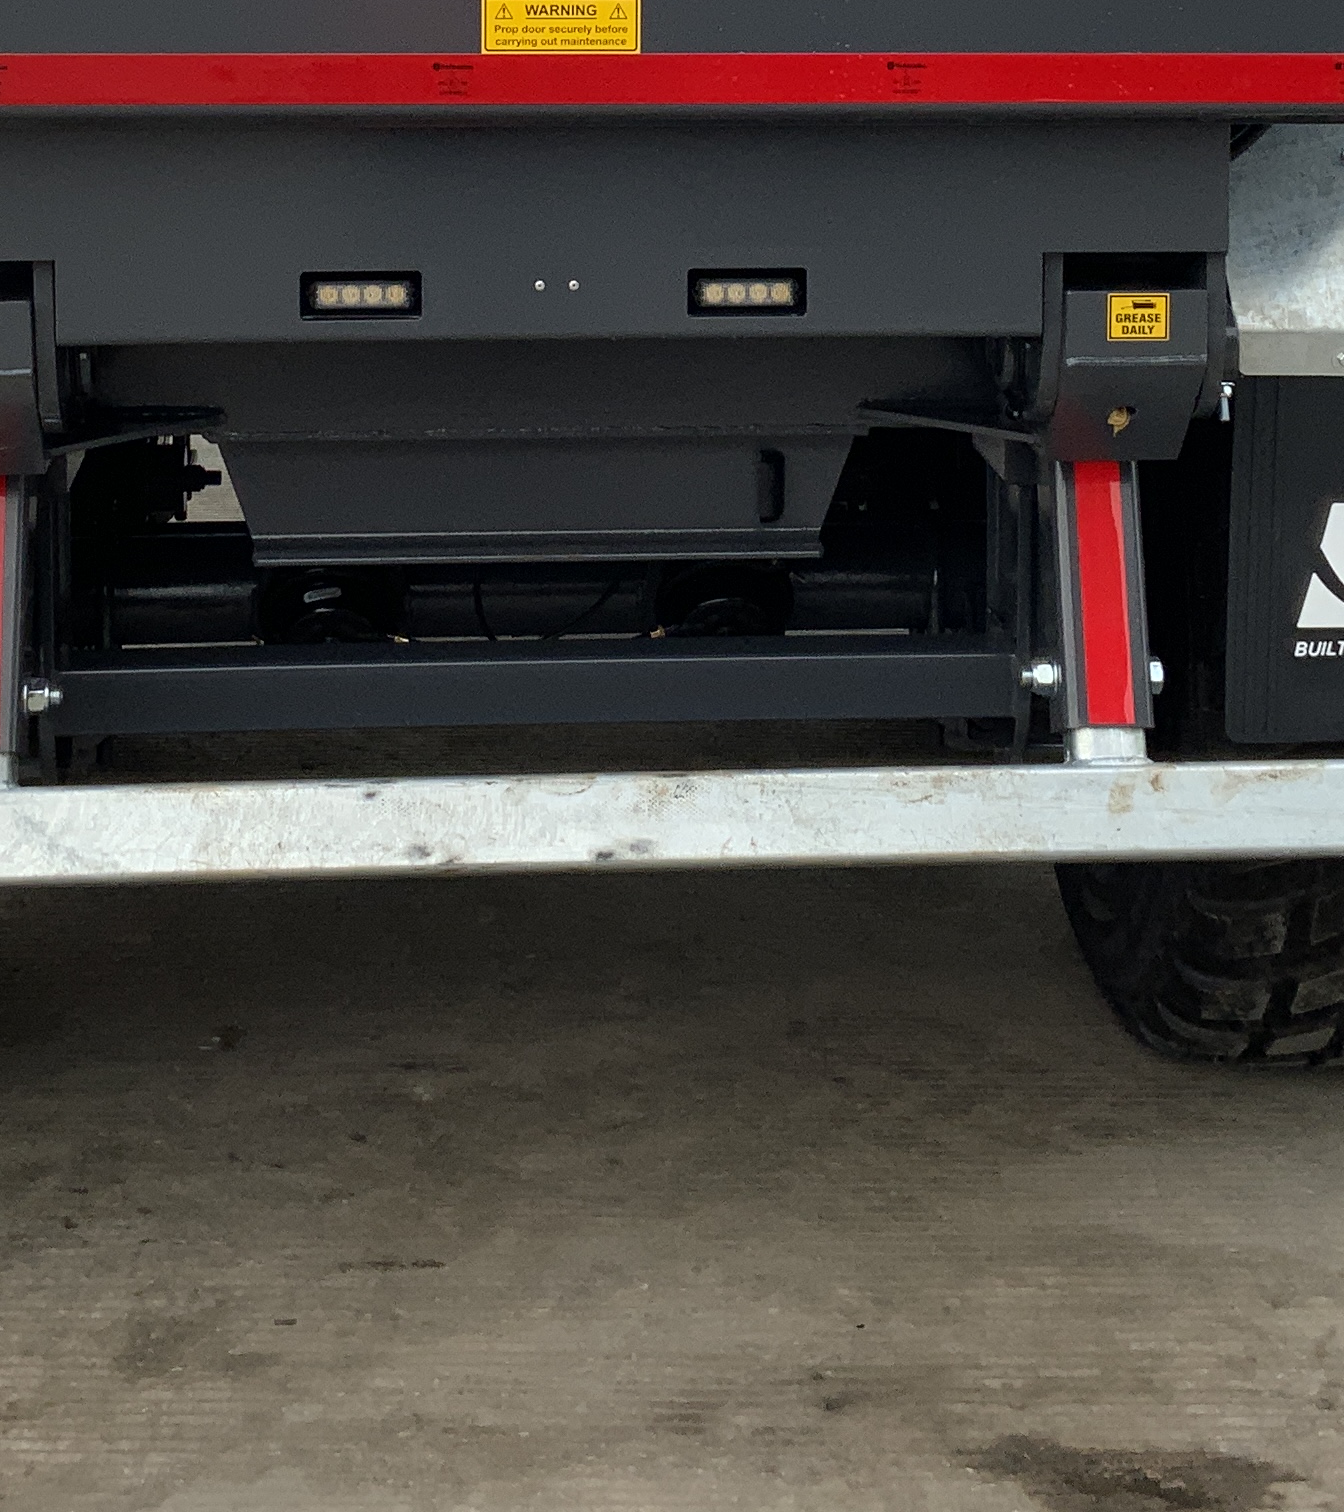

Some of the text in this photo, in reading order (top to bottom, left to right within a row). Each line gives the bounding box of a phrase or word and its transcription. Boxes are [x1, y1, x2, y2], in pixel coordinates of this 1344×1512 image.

[524, 4, 598, 16] WARNING
[494, 24, 628, 35] Prop door securely before
[495, 37, 627, 48] carrying out maintenance
[1115, 313, 1162, 323] GREASE
[1121, 325, 1156, 335] DAILY
